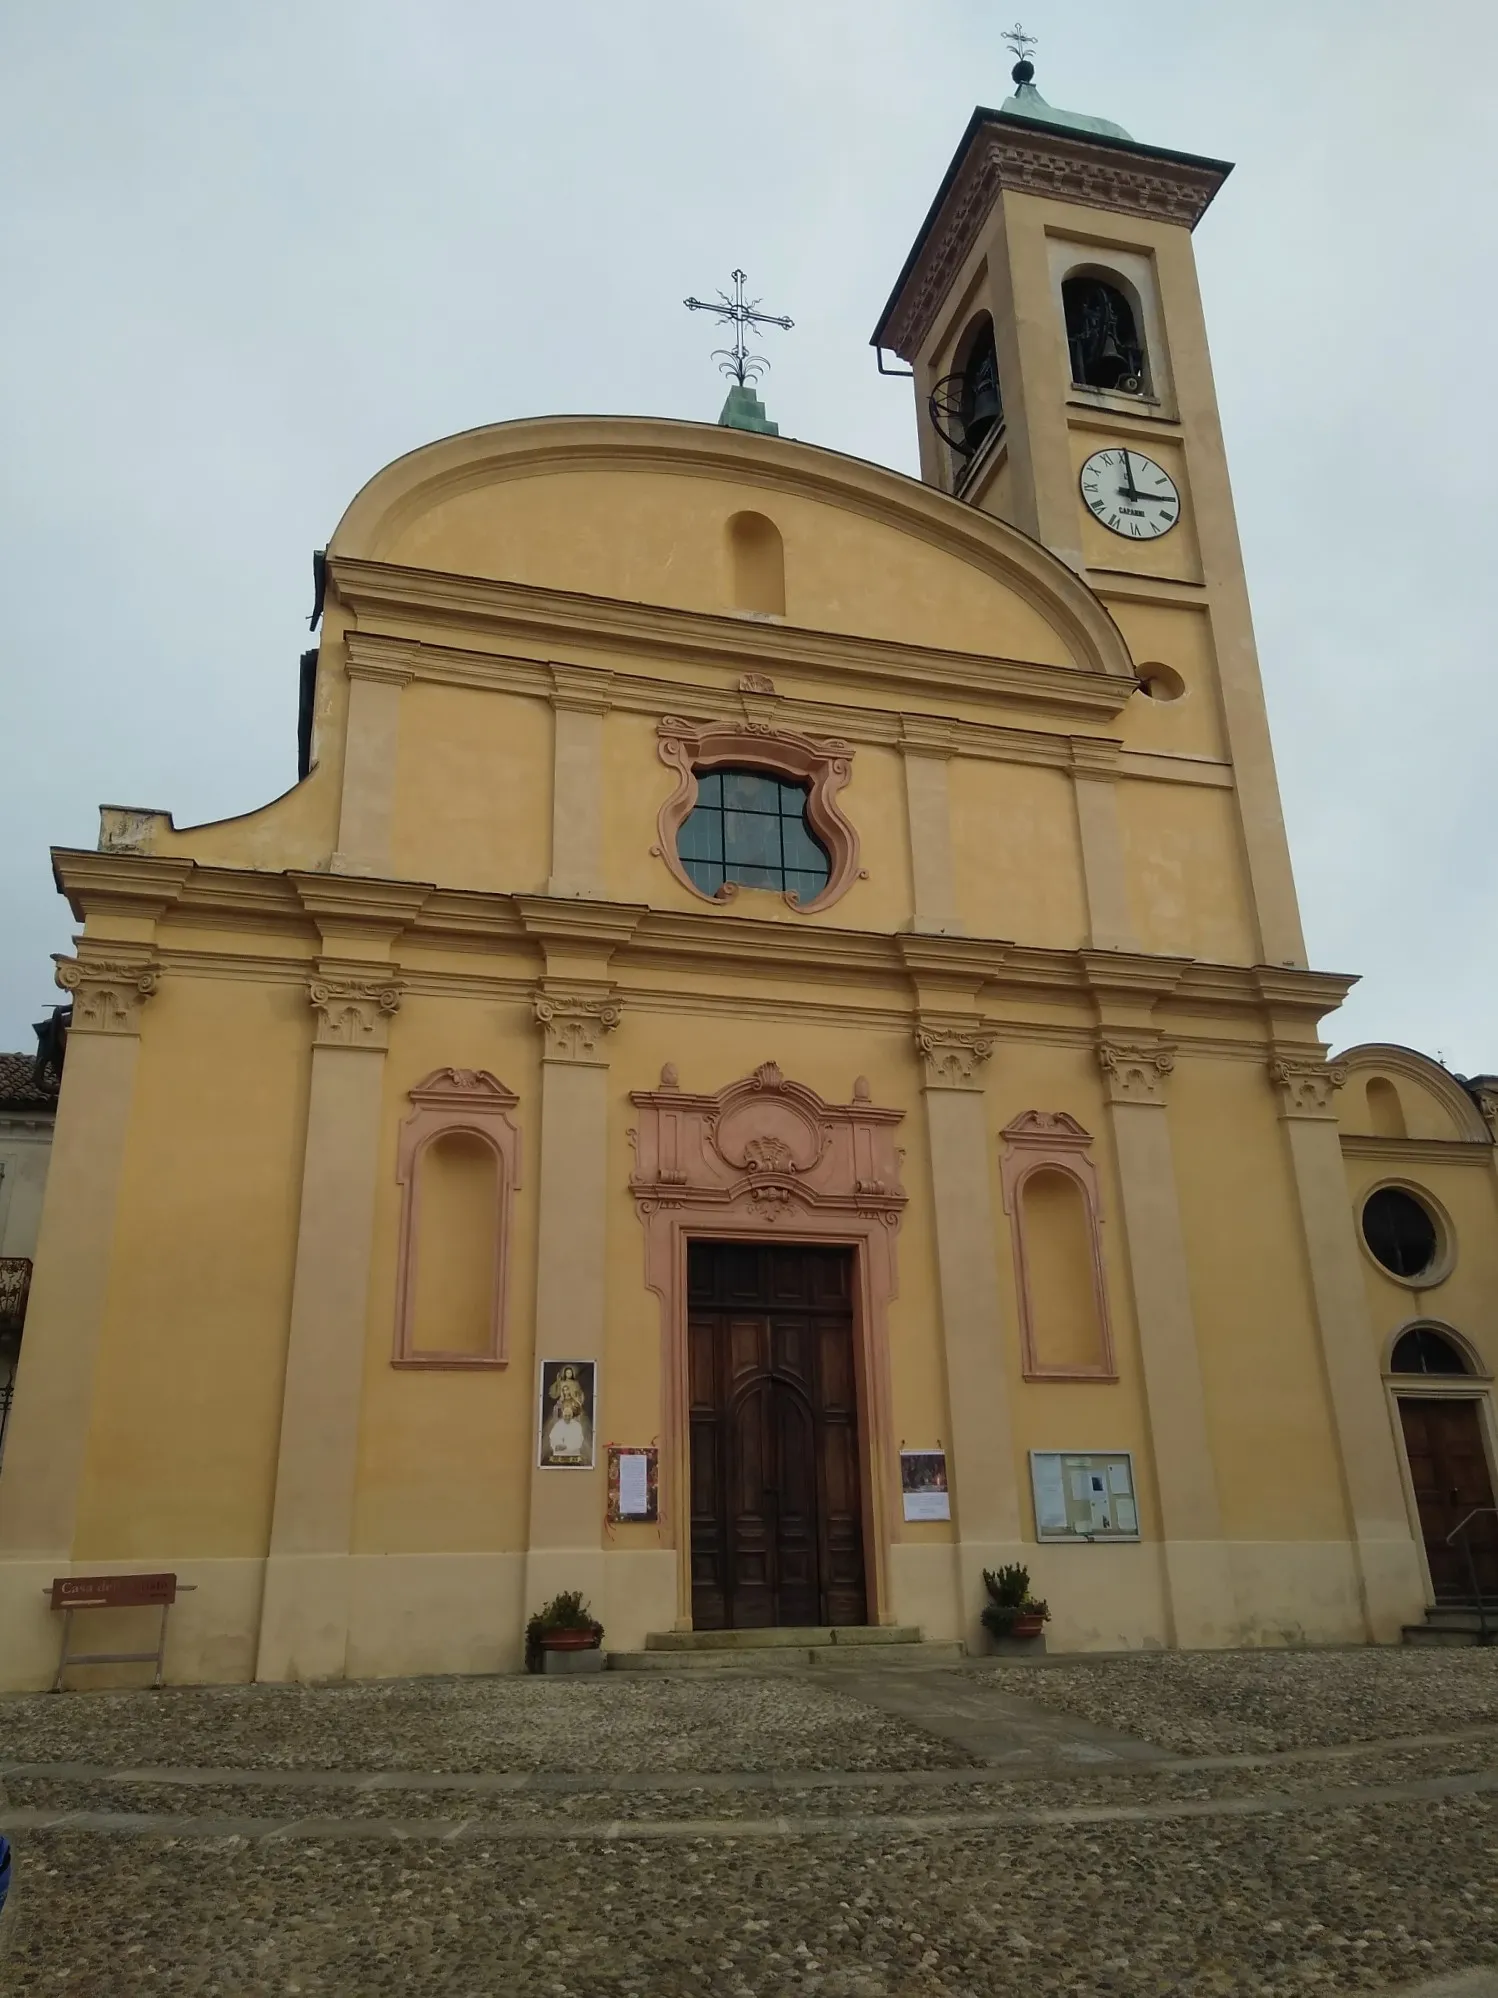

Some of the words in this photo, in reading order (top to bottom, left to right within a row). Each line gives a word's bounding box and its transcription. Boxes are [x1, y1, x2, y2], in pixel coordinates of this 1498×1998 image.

[1099, 452, 1114, 467] XI
[1086, 464, 1101, 477] X
[1083, 482, 1099, 493] IX
[1129, 522, 1142, 536] VI
[1149, 521, 1161, 534] V
